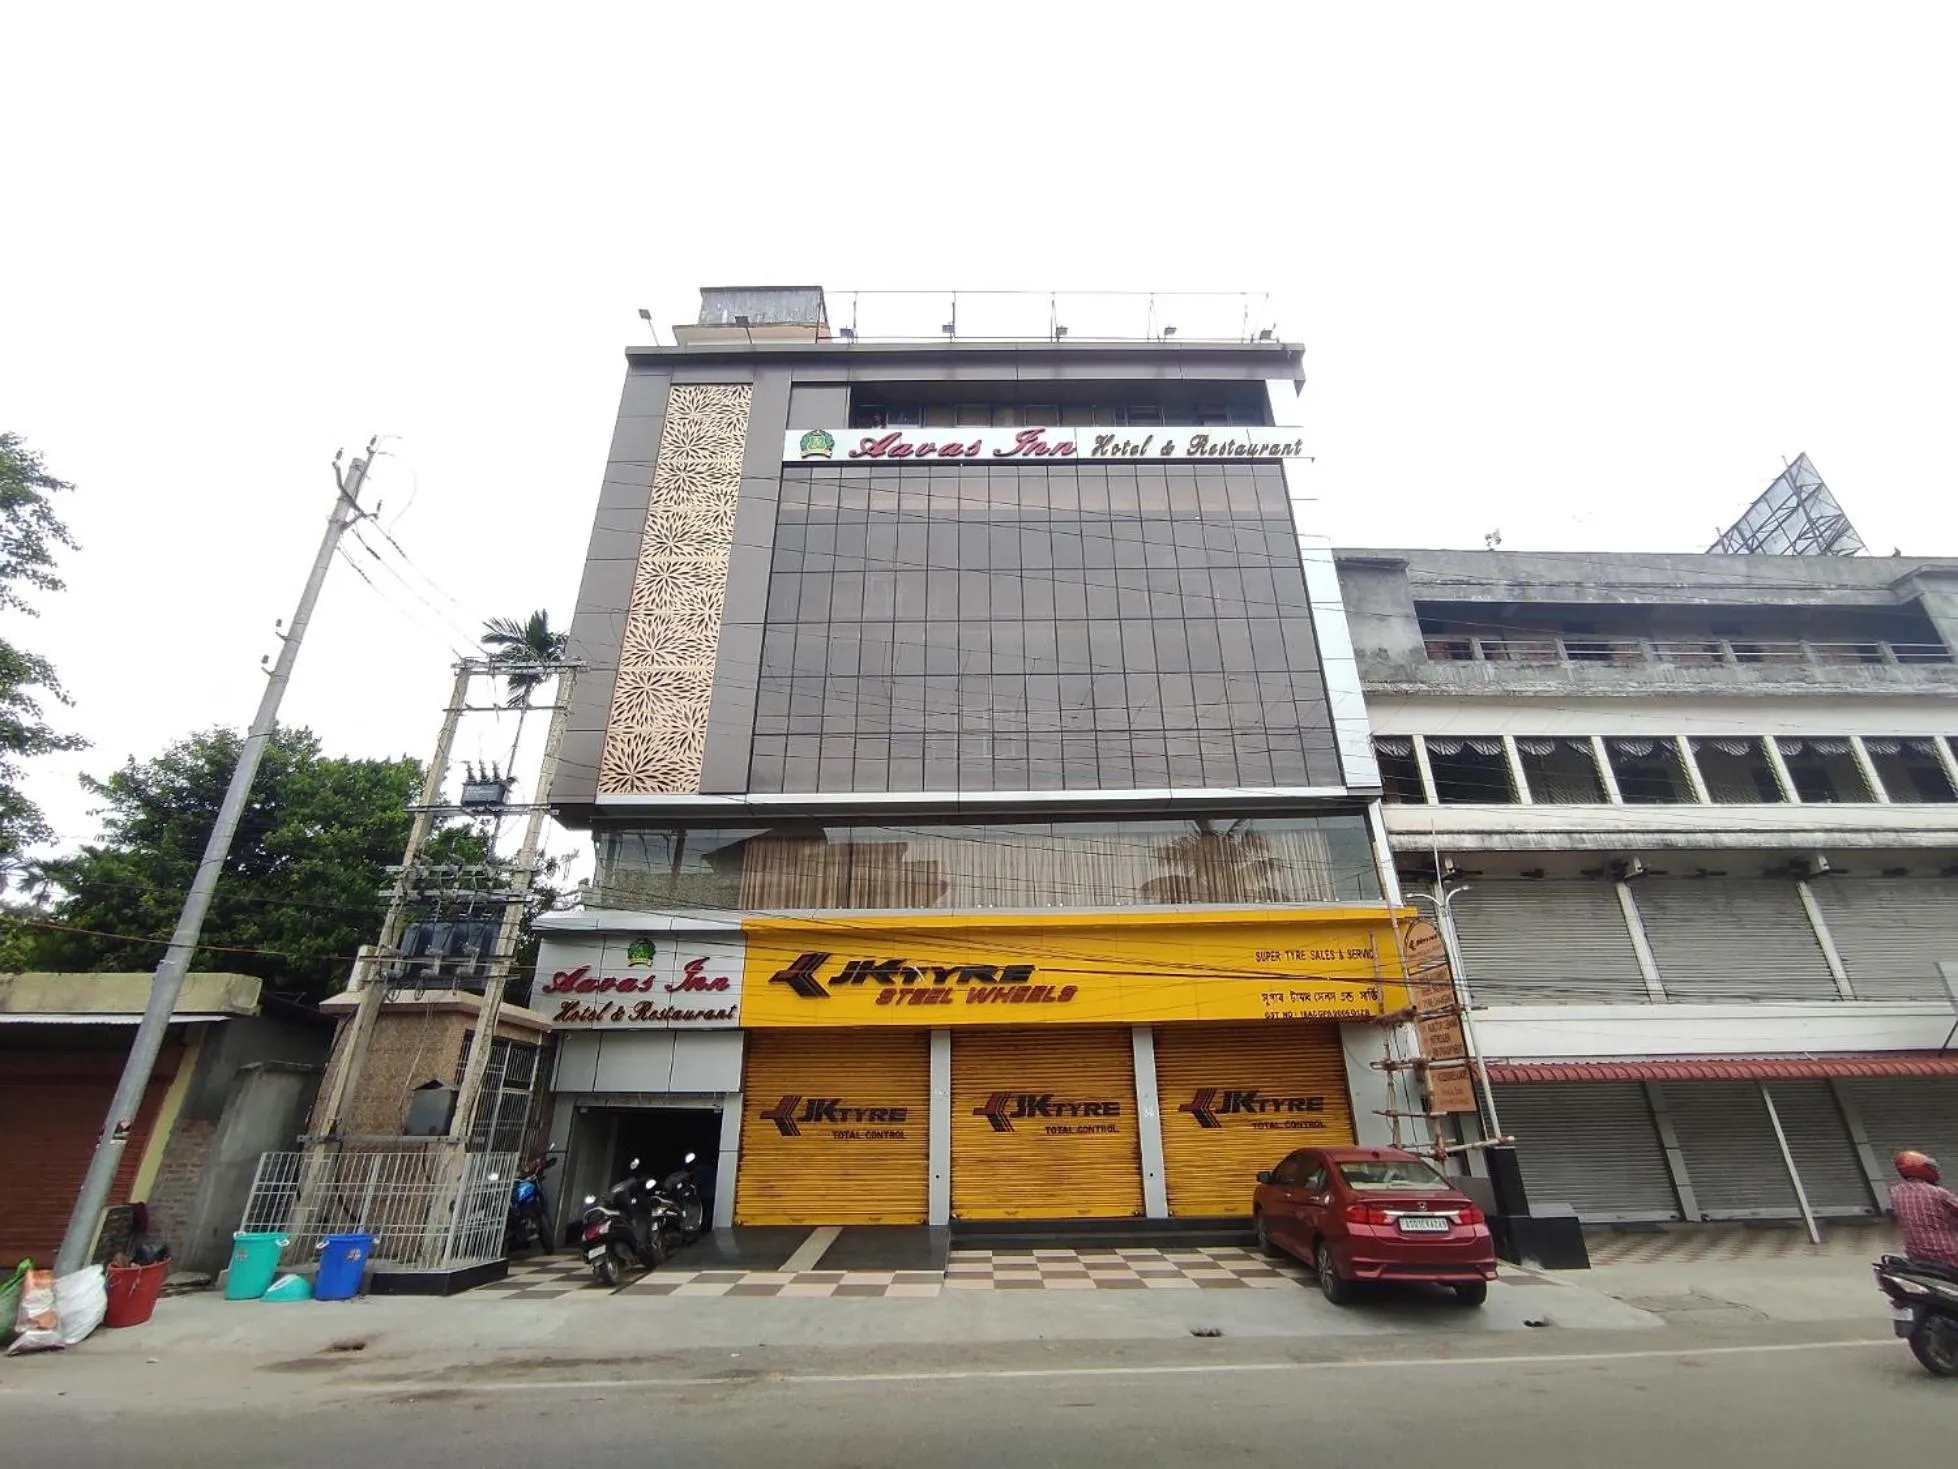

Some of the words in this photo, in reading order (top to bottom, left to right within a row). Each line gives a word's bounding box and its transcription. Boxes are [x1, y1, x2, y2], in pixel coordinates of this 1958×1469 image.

[849, 431, 982, 458] Aavas
[993, 427, 1077, 458] Inn
[1091, 434, 1153, 456] Hotel
[1160, 439, 1175, 456] &
[1187, 434, 1304, 457] Restaurant
[1255, 951, 1281, 962] SUPER
[1285, 950, 1306, 961] TYRE
[1311, 950, 1335, 960] SALES
[542, 965, 656, 993] Aavas
[664, 957, 730, 992] Inn
[875, 987, 953, 1006] STEEL
[965, 985, 1078, 1004] WHEELS
[553, 1001, 613, 1022] Hotel
[610, 1005, 625, 1021] &
[628, 1000, 738, 1021] Restaurant
[833, 1130, 860, 1139] TOTAL
[866, 1130, 907, 1139] CONTROL
[1045, 1125, 1073, 1134] TOTAL
[1078, 1124, 1120, 1133] CONTROL
